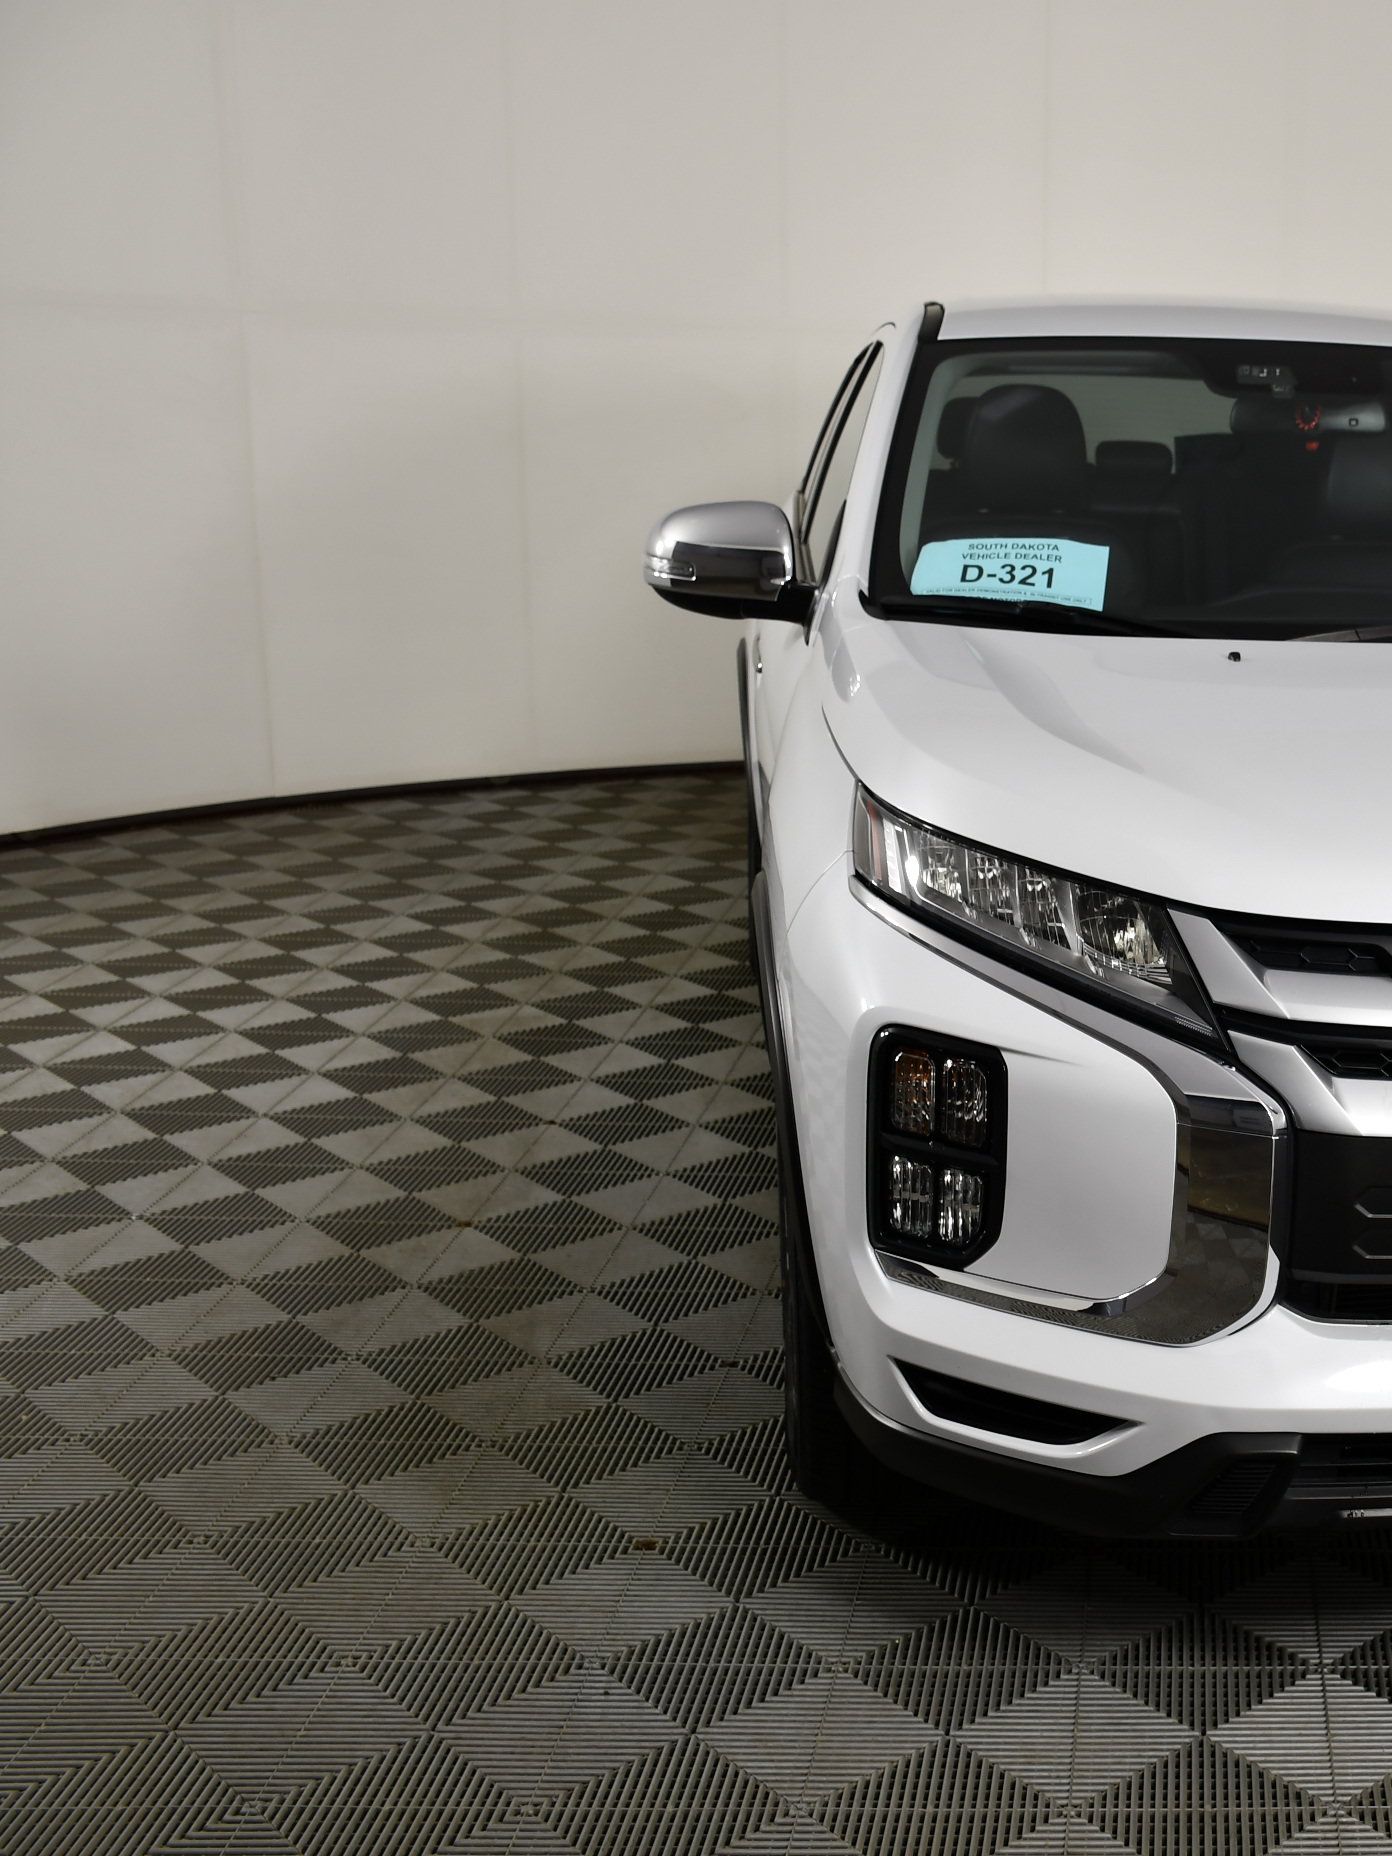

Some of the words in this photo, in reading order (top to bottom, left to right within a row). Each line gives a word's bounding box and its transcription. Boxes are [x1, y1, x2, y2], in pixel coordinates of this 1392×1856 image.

[968, 543, 1008, 551] SOUTH
[1011, 543, 1060, 552] DAKOTA
[962, 552, 1011, 561] VEHICLE
[1015, 552, 1063, 564] DEALER
[960, 563, 1055, 589] D-321
